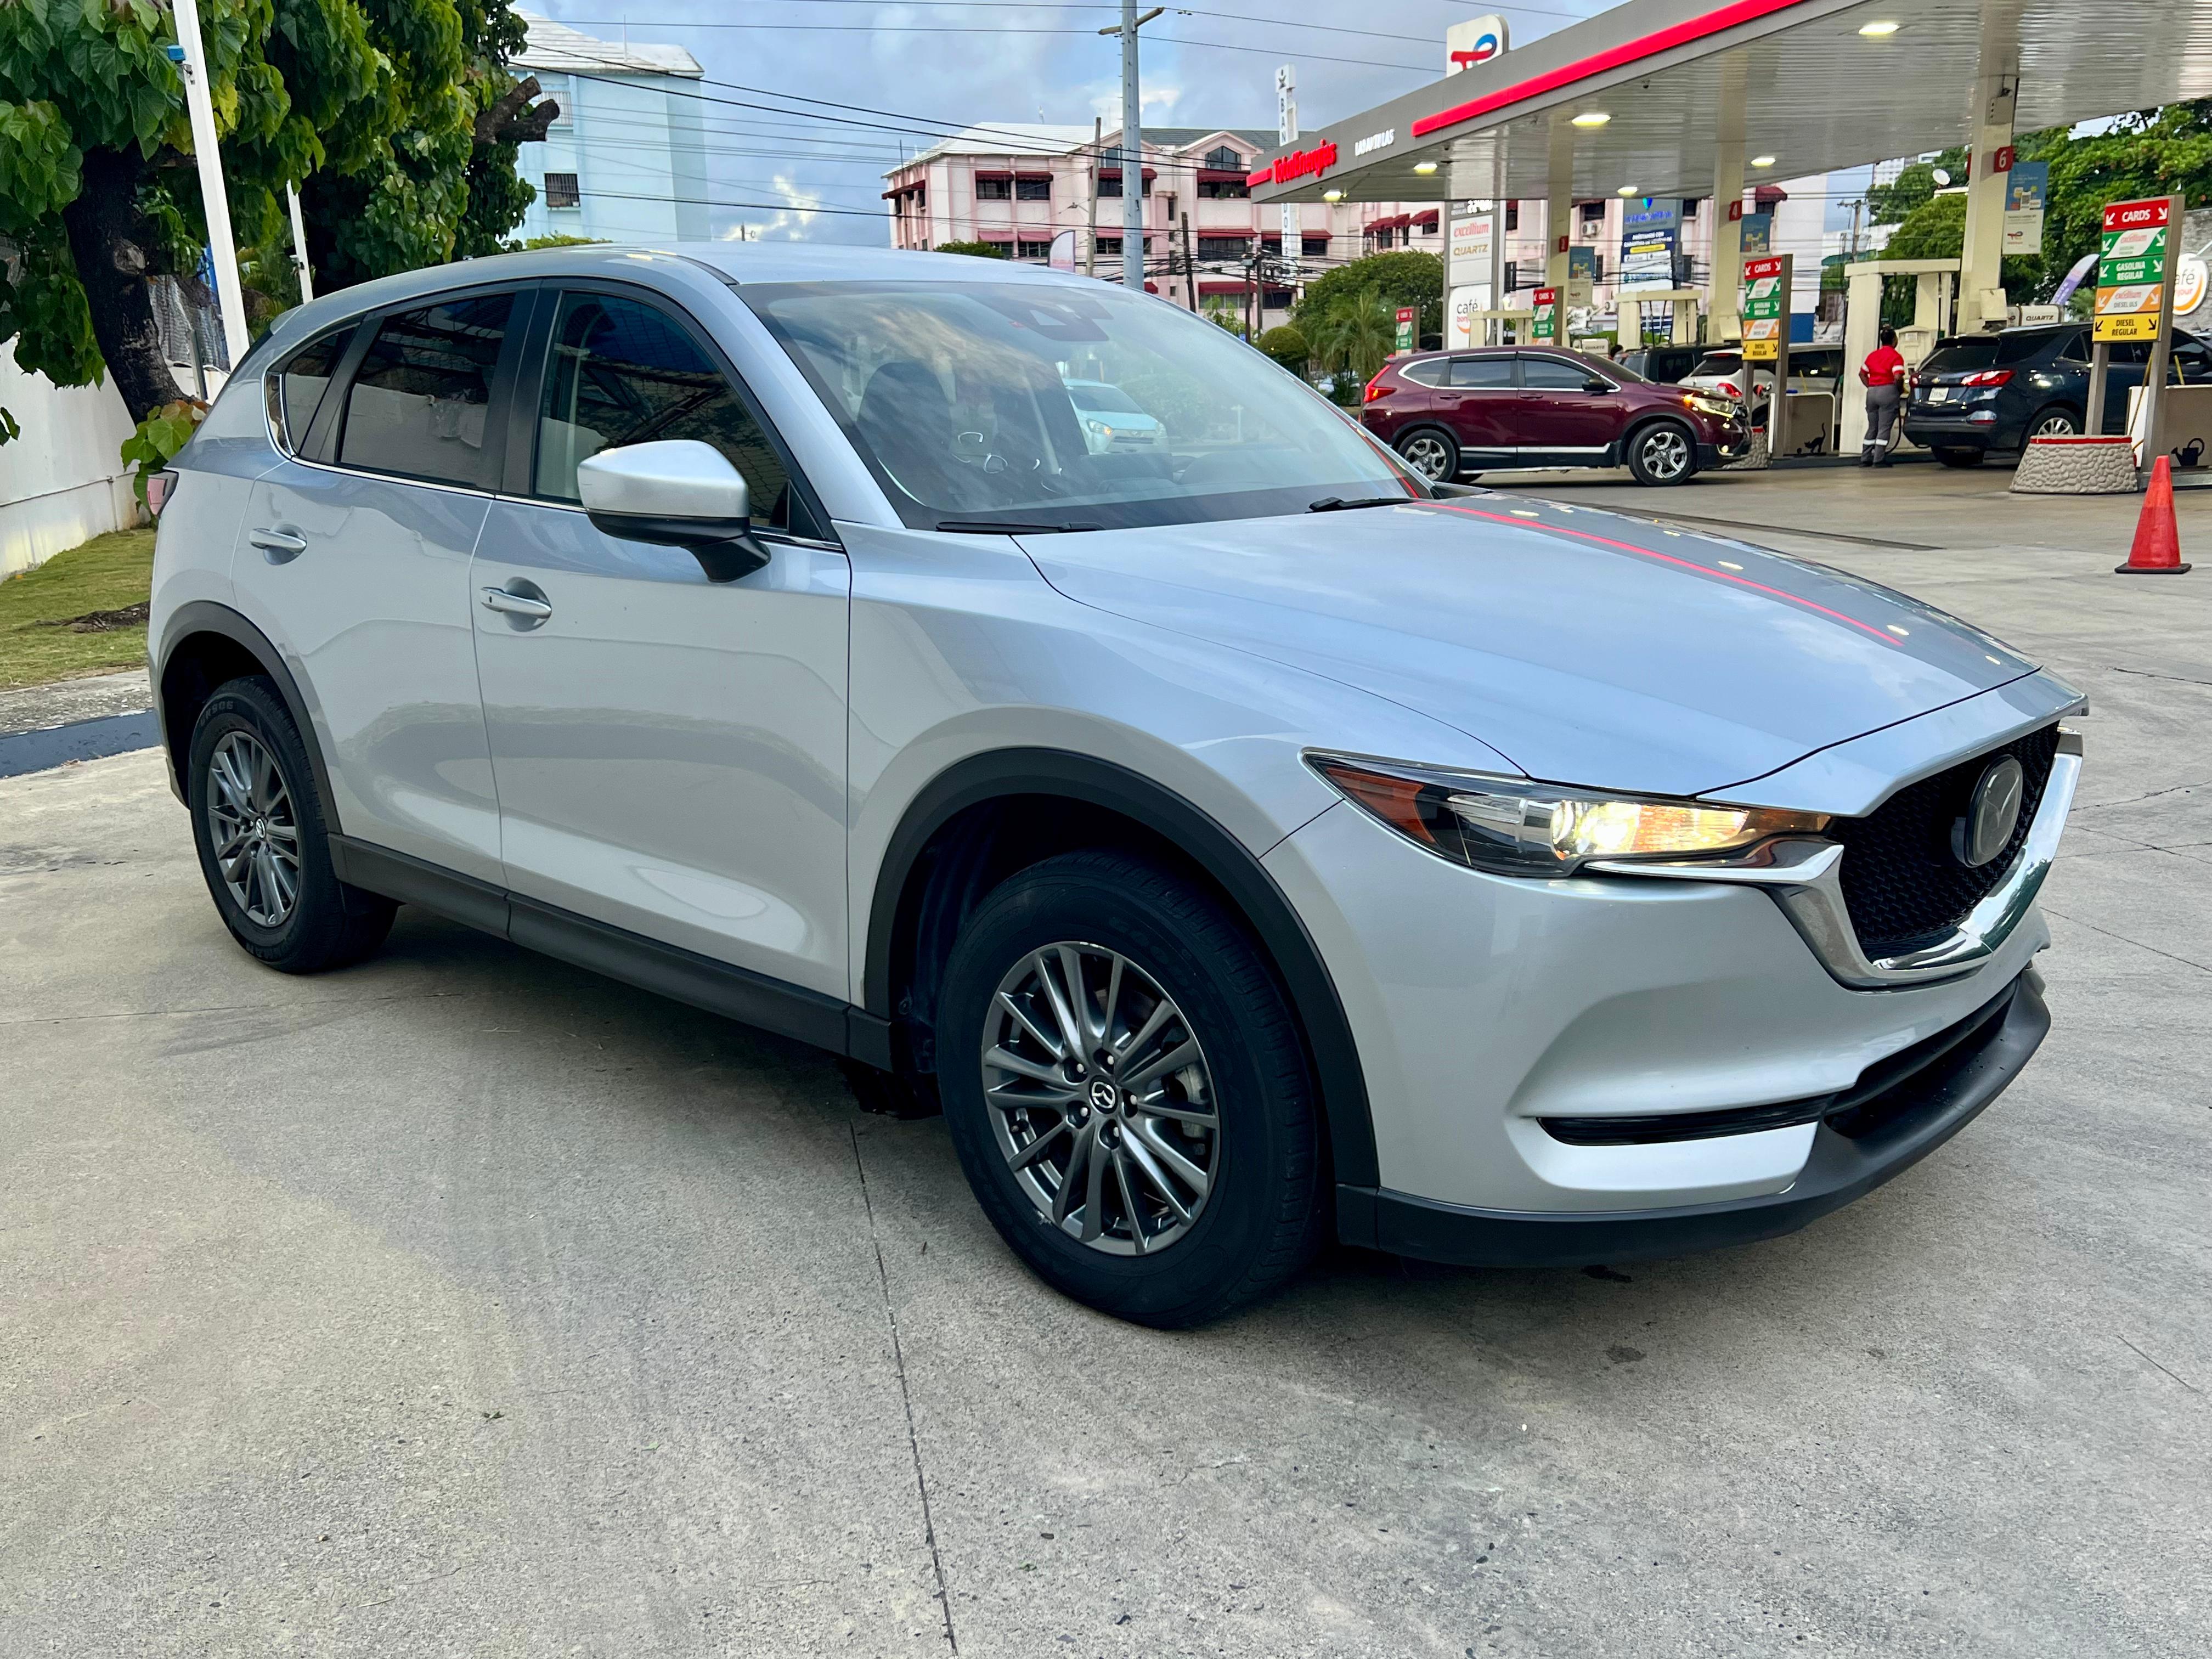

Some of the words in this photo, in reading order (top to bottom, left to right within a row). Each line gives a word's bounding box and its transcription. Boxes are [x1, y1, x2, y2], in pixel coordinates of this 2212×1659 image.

[1999, 150, 2007, 168] 6
[1732, 204, 1738, 218] 4
[2121, 209, 2151, 223] CARDS
[1454, 222, 1489, 238] excellium
[1454, 244, 1488, 256] QUARTZ
[1754, 262, 1771, 274] CARDS
[2116, 261, 2146, 272] GASOLINA
[2117, 270, 2144, 281] REGULAR
[2175, 268, 2194, 285] afé
[1457, 298, 1478, 314] café
[2112, 328, 2138, 336] REGULAR
